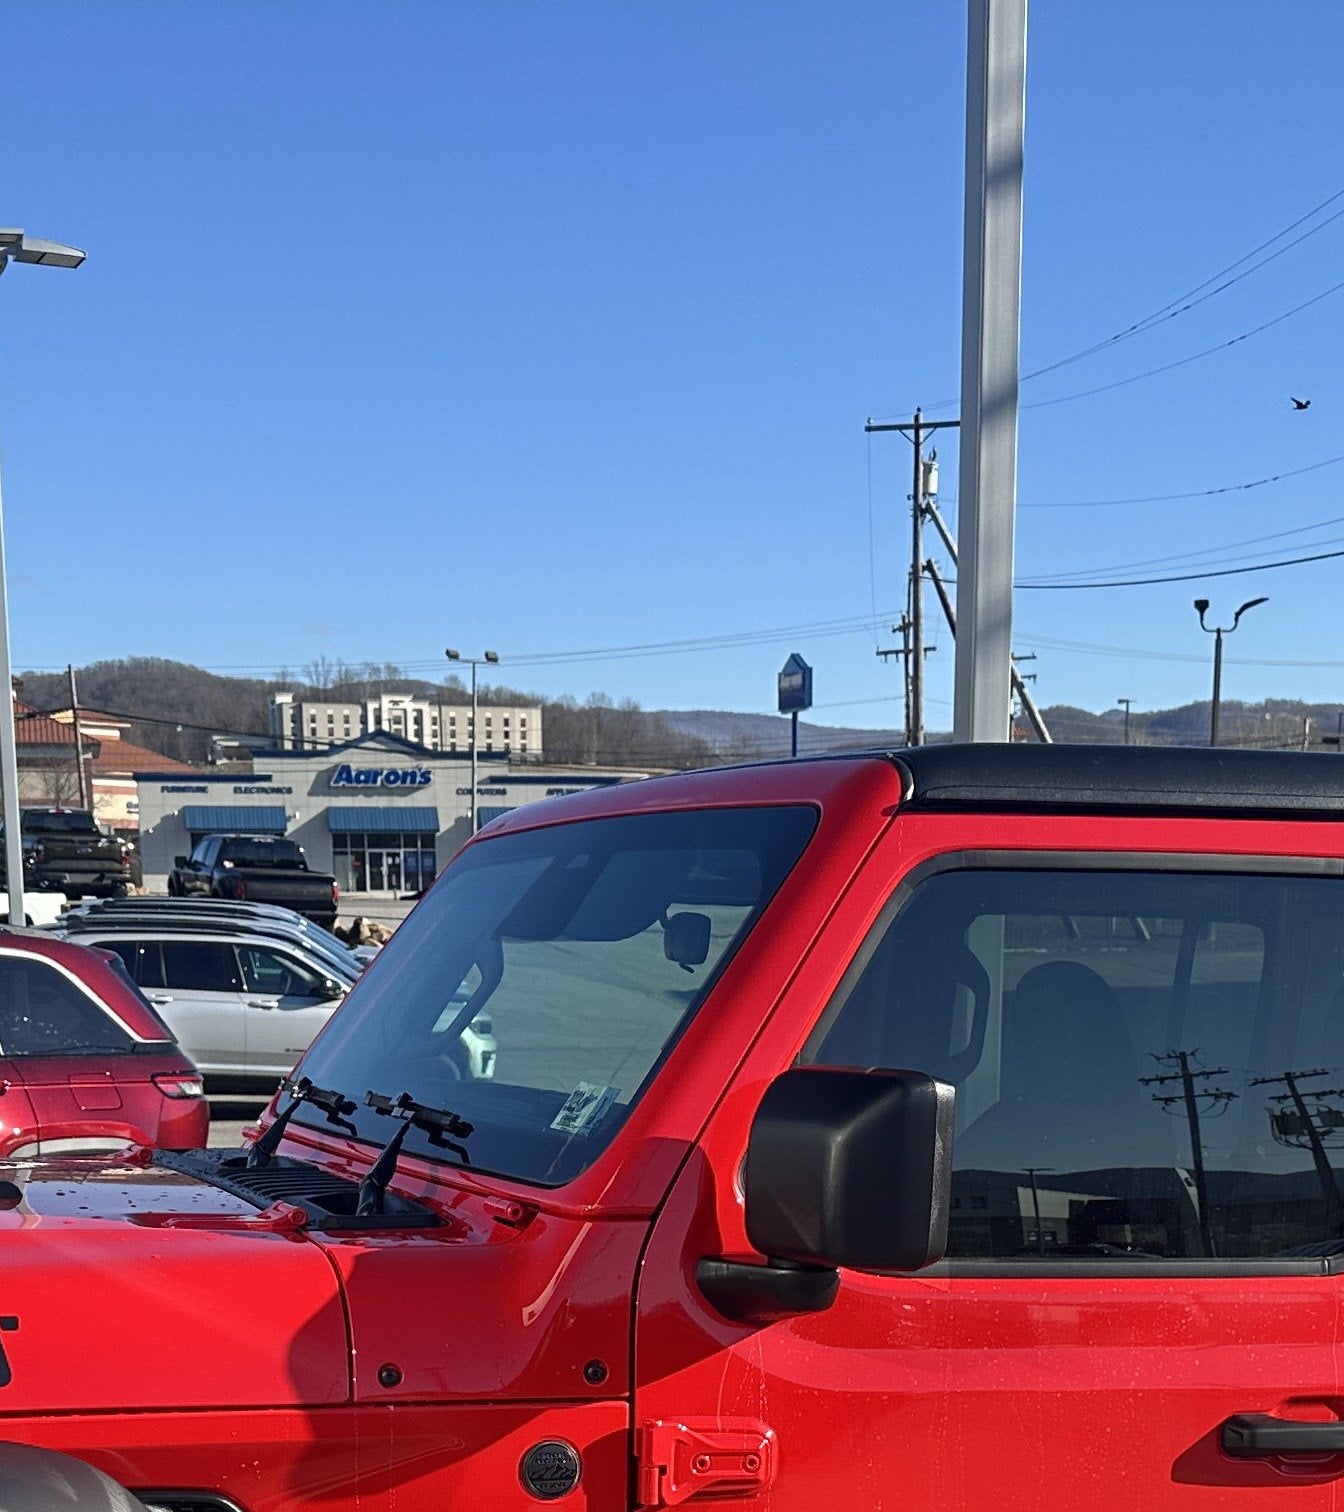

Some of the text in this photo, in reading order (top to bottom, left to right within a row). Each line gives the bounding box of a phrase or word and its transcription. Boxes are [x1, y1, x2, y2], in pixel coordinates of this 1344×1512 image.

[332, 764, 431, 786] Aaron's
[161, 785, 208, 793] FURNITURE
[234, 786, 292, 794] ELECTRONICS
